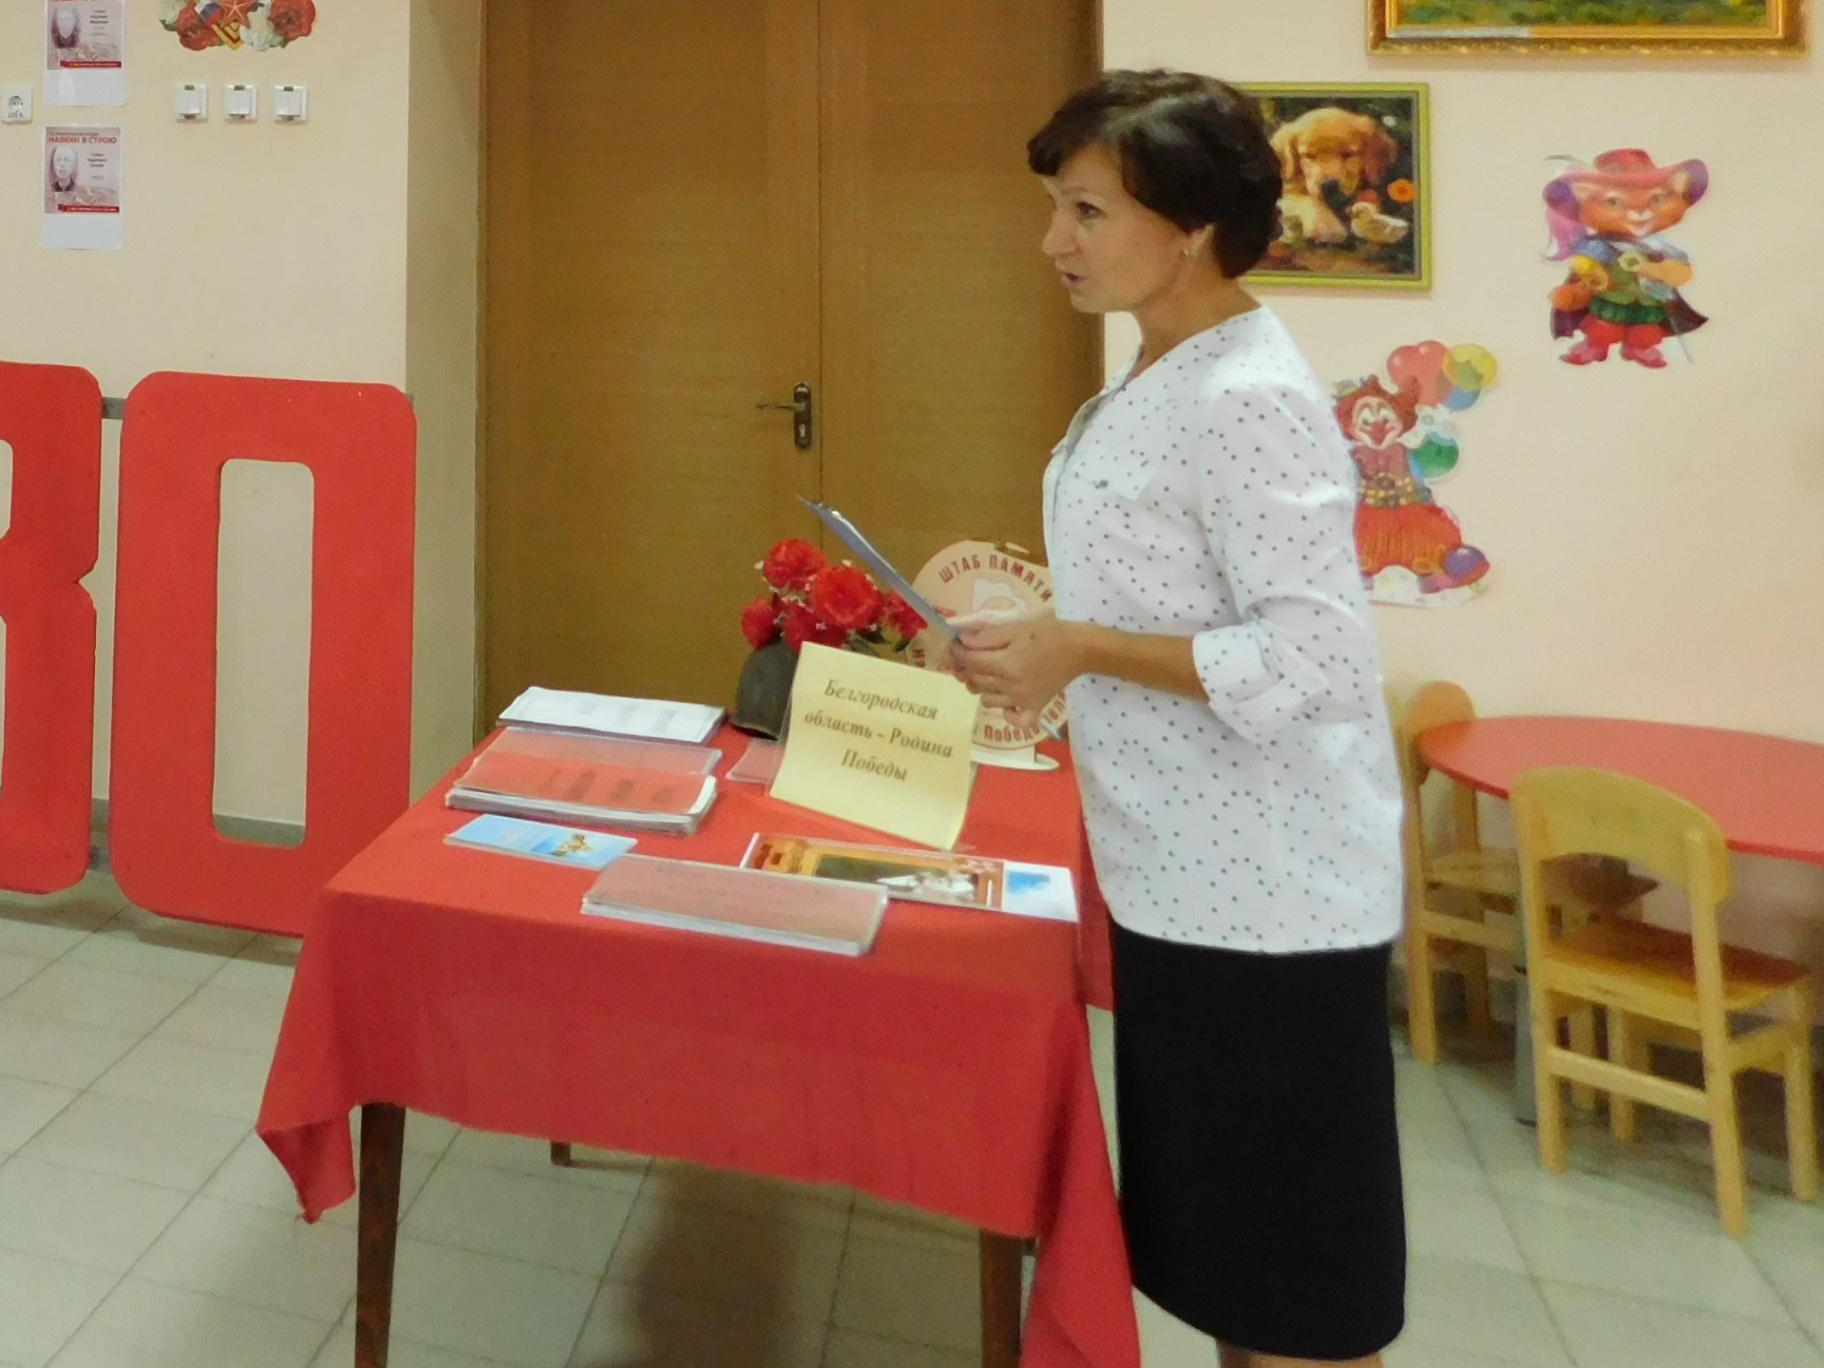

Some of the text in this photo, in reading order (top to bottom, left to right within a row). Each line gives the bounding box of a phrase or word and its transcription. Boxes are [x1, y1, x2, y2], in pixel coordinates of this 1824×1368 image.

[938, 552, 1053, 603] ШТАБ ПАМЯТИ
[824, 679, 938, 720] Белгородская
[804, 710, 872, 739] область
[889, 727, 953, 758] Родина
[841, 748, 908, 781] Победы
